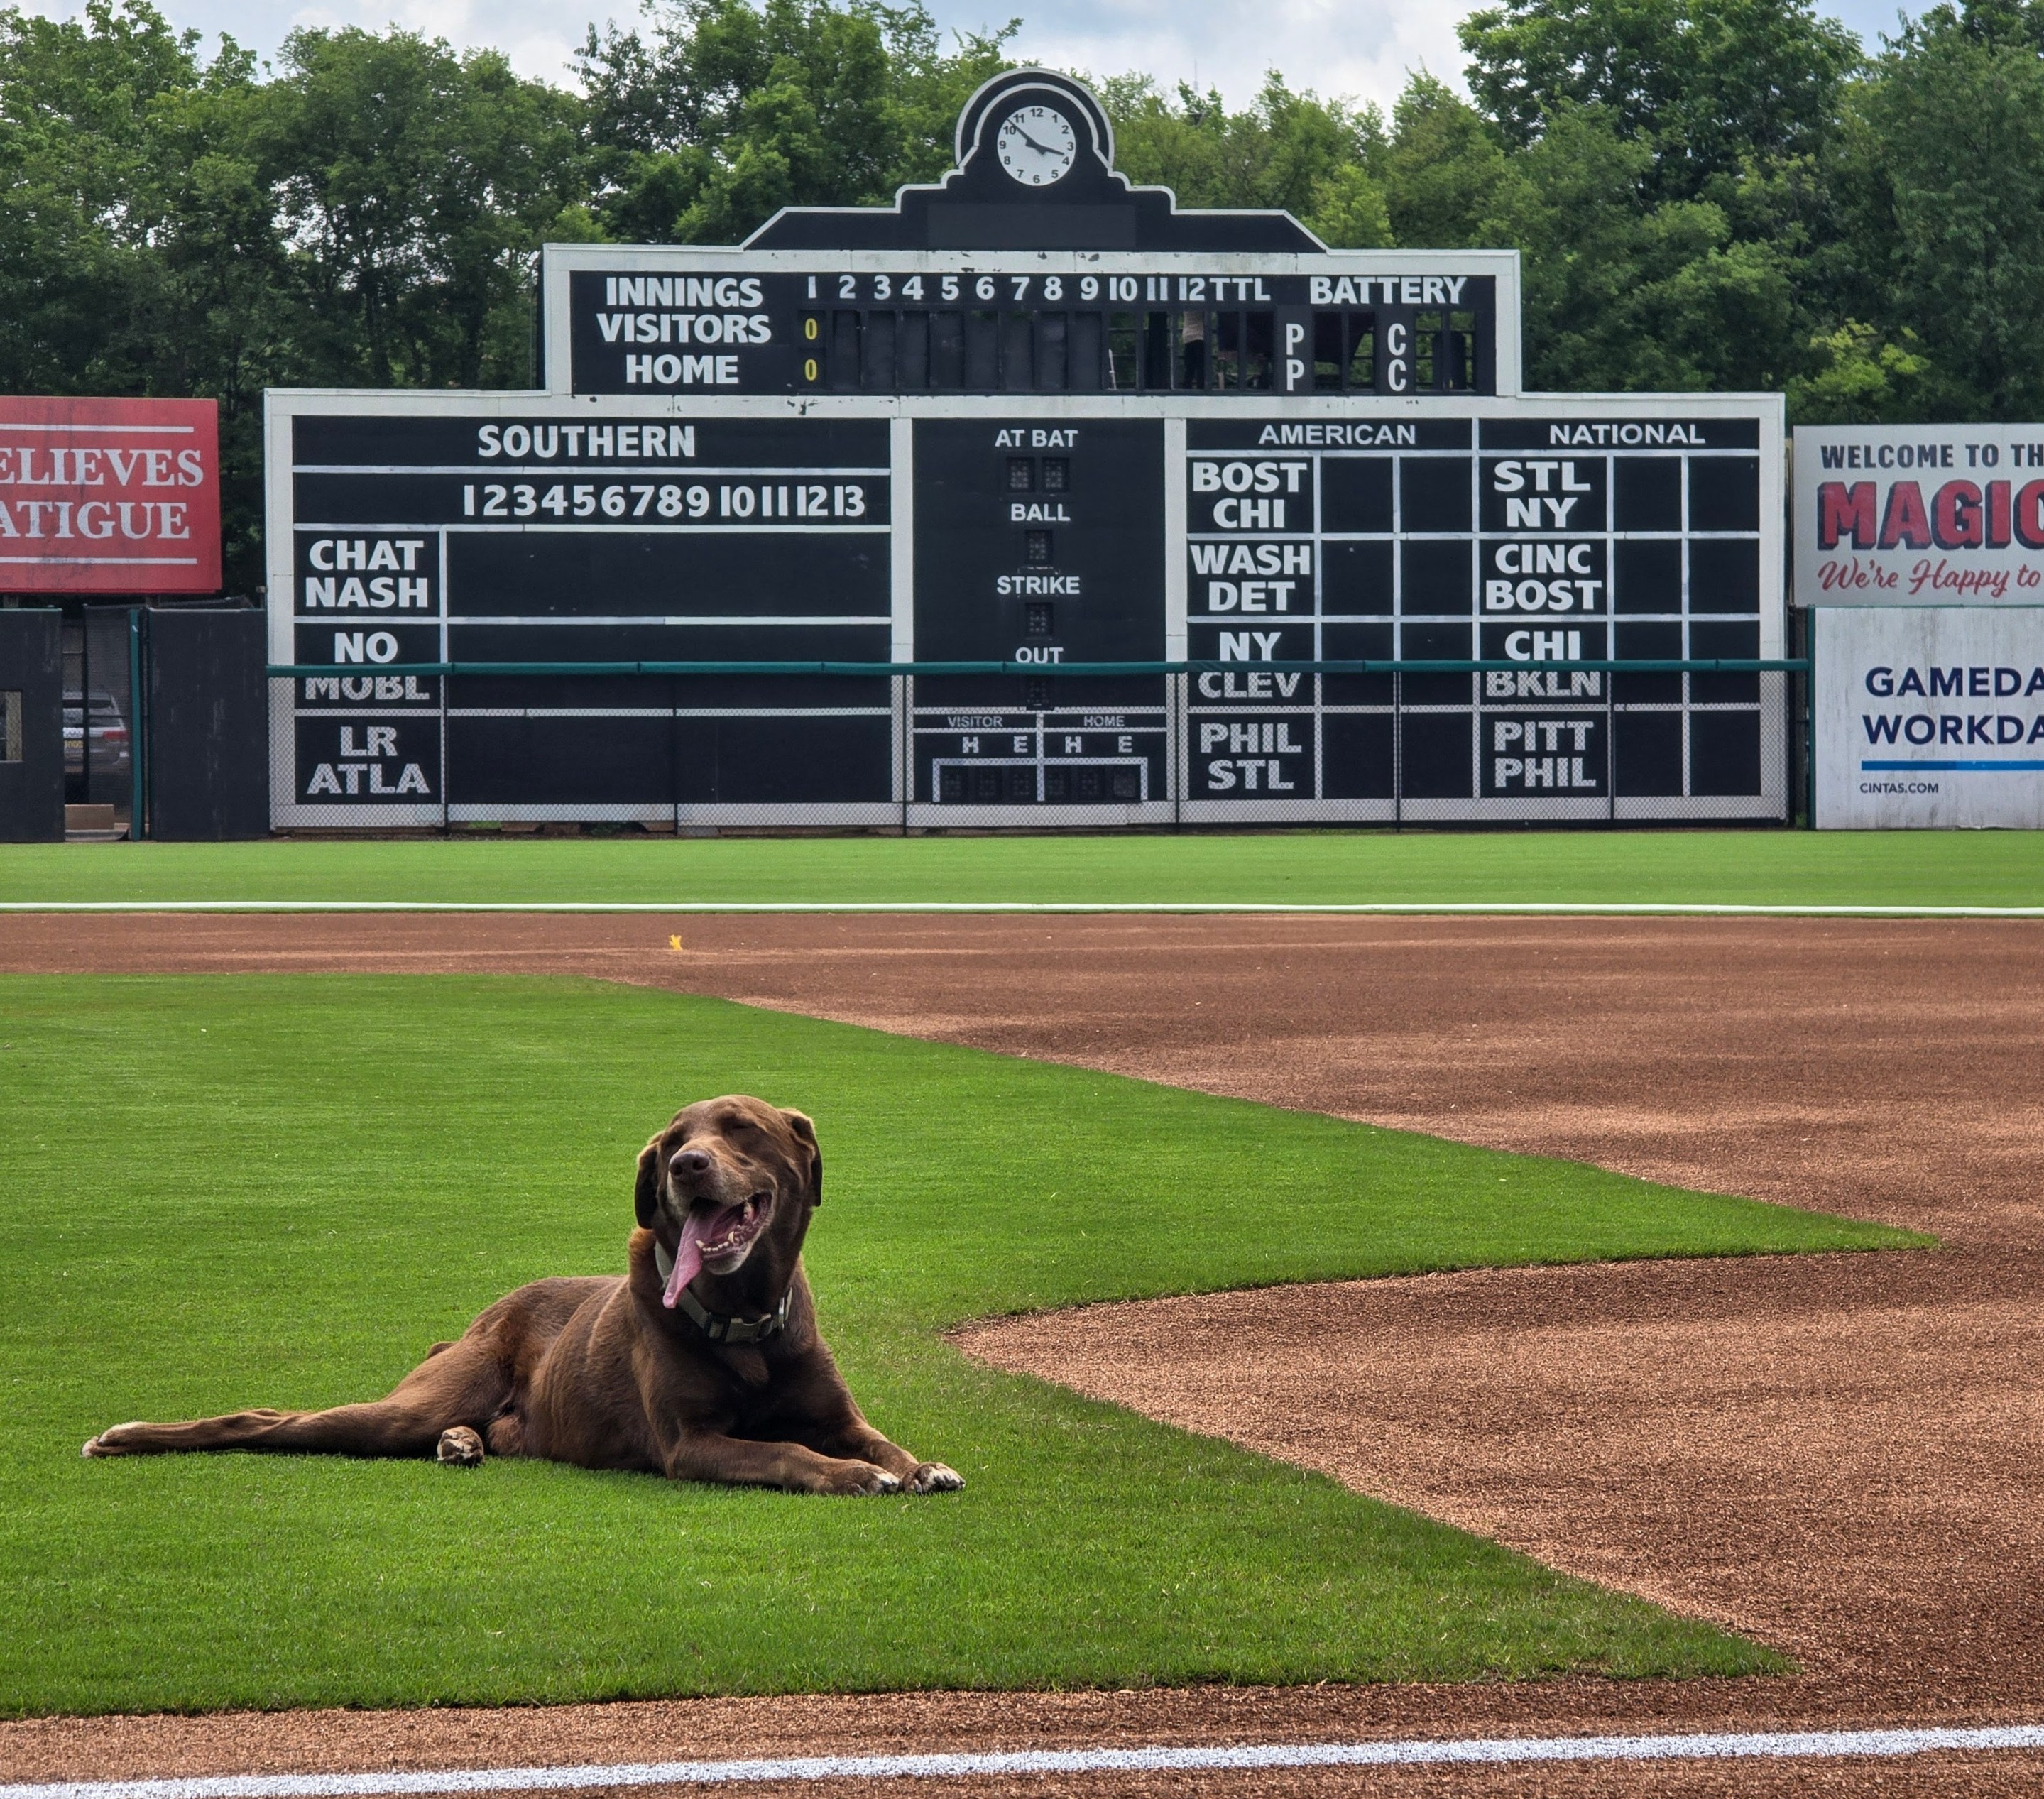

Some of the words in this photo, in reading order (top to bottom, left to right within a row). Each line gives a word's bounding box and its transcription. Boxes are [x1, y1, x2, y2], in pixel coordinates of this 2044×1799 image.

[1013, 114, 1024, 123] 11
[1030, 108, 1044, 117] 12
[1052, 114, 1058, 123] 1
[1003, 126, 1016, 135] 10
[1062, 126, 1069, 134] 2
[1000, 141, 1007, 149] 9
[1067, 142, 1074, 151] 3
[1004, 156, 1011, 165] 8
[1062, 157, 1070, 165] 4
[1017, 170, 1024, 178] 7
[1051, 170, 1059, 178] 5
[606, 278, 763, 307] INNINGS
[808, 276, 816, 299] 1
[838, 275, 856, 299] 2
[874, 275, 892, 300] 3
[902, 276, 924, 300] 4
[941, 276, 959, 300] 5
[975, 277, 995, 300] 6
[1012, 277, 1030, 300] 7
[1044, 276, 1063, 300] 8
[1081, 277, 1098, 300] 9
[1109, 277, 1138, 301] 10
[1147, 278, 1168, 301] 11
[1179, 278, 1206, 301] 12
[1209, 278, 1271, 301] TTL
[1310, 277, 1468, 304] BATTERY
[596, 314, 772, 343] VISITORS
[804, 318, 817, 340] 0
[1286, 324, 1304, 355] P
[1387, 324, 1406, 356] C
[626, 354, 739, 384] HOME
[804, 359, 817, 381] 0
[1286, 359, 1304, 391] P
[1387, 359, 1406, 392] C
[478, 425, 695, 458] SOUTHERN
[995, 430, 1025, 447] AT
[1032, 430, 1078, 447] BAT
[1259, 424, 1416, 445] AMERICAN
[1550, 424, 1706, 444] NATIONAL
[1820, 444, 1954, 469] WELCOME
[1966, 444, 1999, 468] TO
[1193, 462, 1308, 493] BOST
[1494, 460, 1591, 492] STL
[1010, 503, 1071, 522] BALL
[1213, 498, 1285, 529] CHI
[1506, 498, 1578, 527] NY
[309, 540, 425, 571] CHAT
[1191, 545, 1311, 575] WASH
[1495, 544, 1591, 574] CINC
[997, 576, 1080, 594] STRIKE
[1818, 557, 1898, 591] We're
[1908, 559, 2010, 598] Happy
[2016, 564, 2041, 588] to
[305, 577, 428, 608] NASH
[1208, 581, 1296, 611] DET
[1485, 580, 1602, 611] BOST
[334, 632, 398, 664] NO
[1015, 647, 1064, 664] OUT
[1219, 631, 1282, 661] NY
[1504, 631, 1580, 661] CHI
[305, 677, 430, 701] MOBL
[1198, 672, 1301, 699] CLEV
[1486, 671, 1600, 697] BKLN
[947, 716, 1003, 728] VISITOR
[1083, 716, 1125, 727] HOME
[340, 726, 398, 757] LR
[962, 736, 980, 754] H
[1013, 736, 1029, 753] E
[1064, 736, 1082, 754] H
[1117, 736, 1133, 753] E
[1200, 723, 1302, 753] PHIL
[1494, 721, 1595, 752] PITT
[306, 763, 430, 794] ATLA
[1208, 760, 1294, 789] STL
[1494, 757, 1597, 787] PHIL
[1859, 782, 1939, 794] CINTAS.COM
